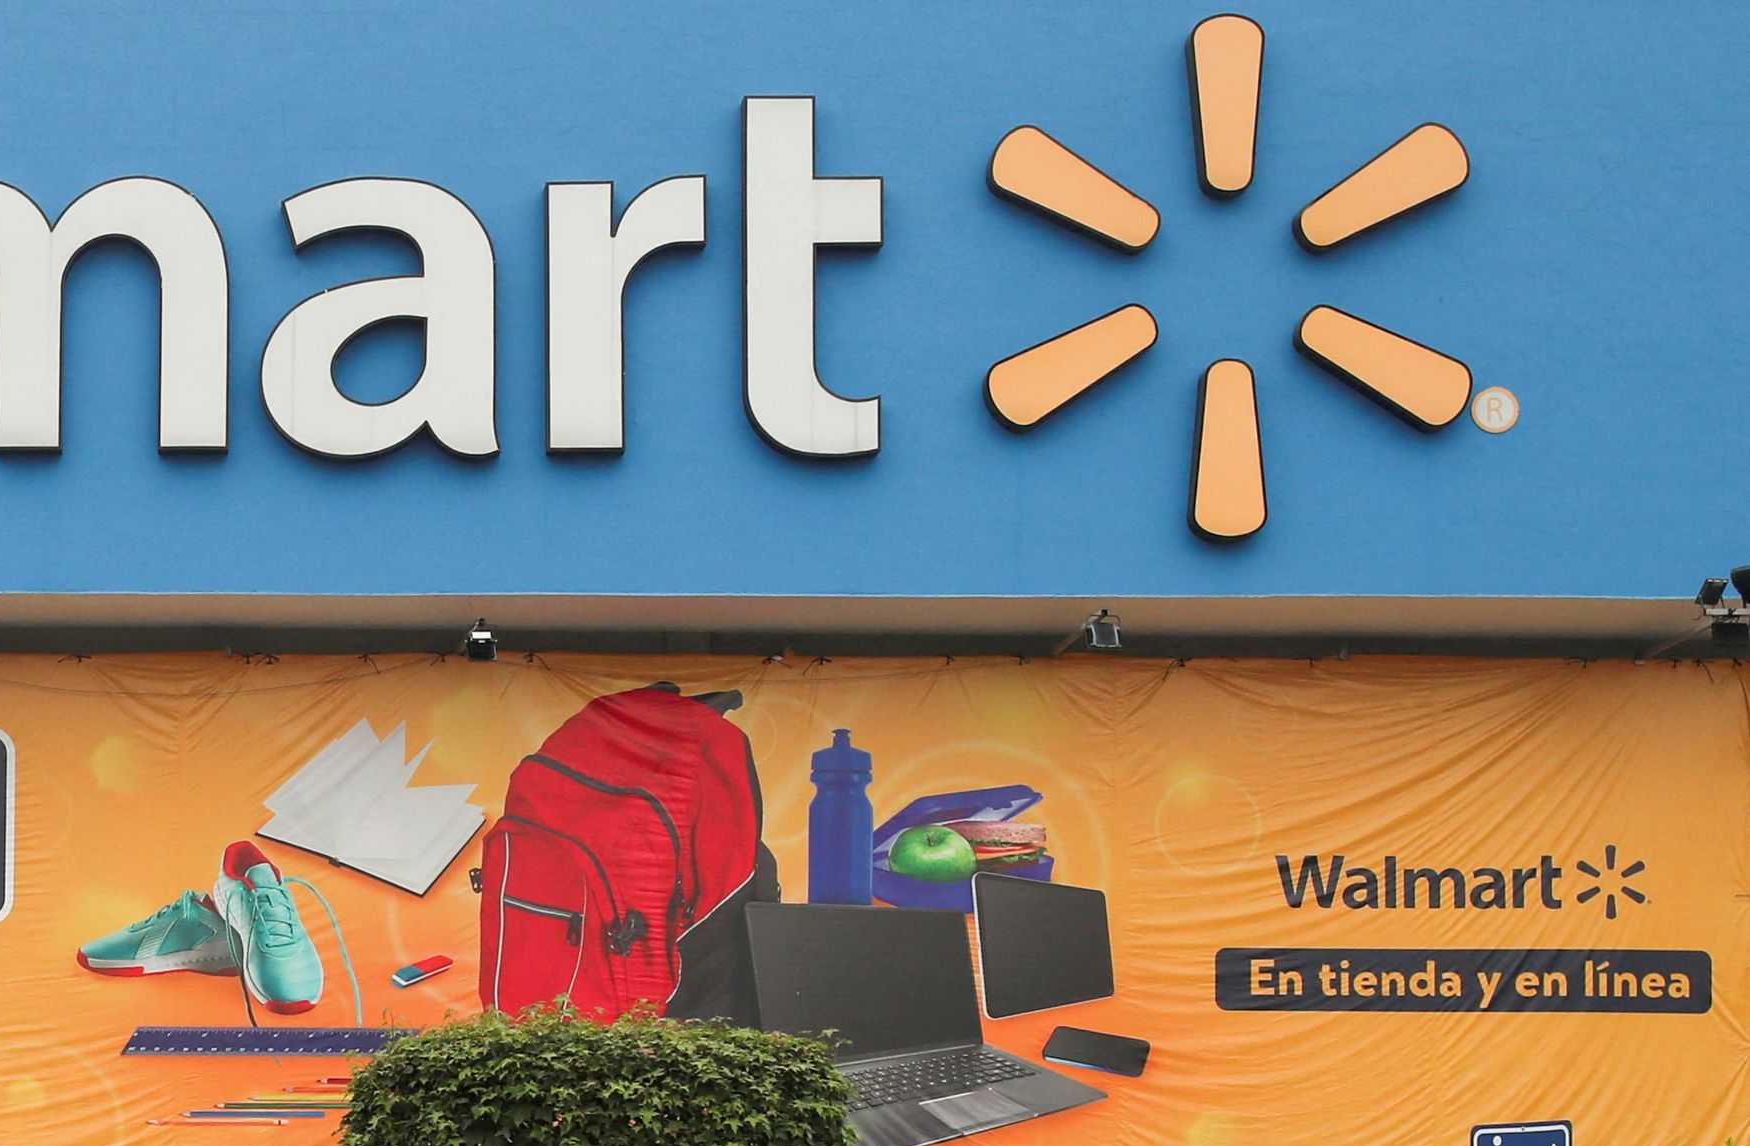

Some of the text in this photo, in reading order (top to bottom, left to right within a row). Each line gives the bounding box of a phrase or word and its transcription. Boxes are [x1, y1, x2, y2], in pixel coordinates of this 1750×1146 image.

[1275, 854, 1563, 910] Walmart
[1250, 958, 1691, 1009] En tienda y en línea
